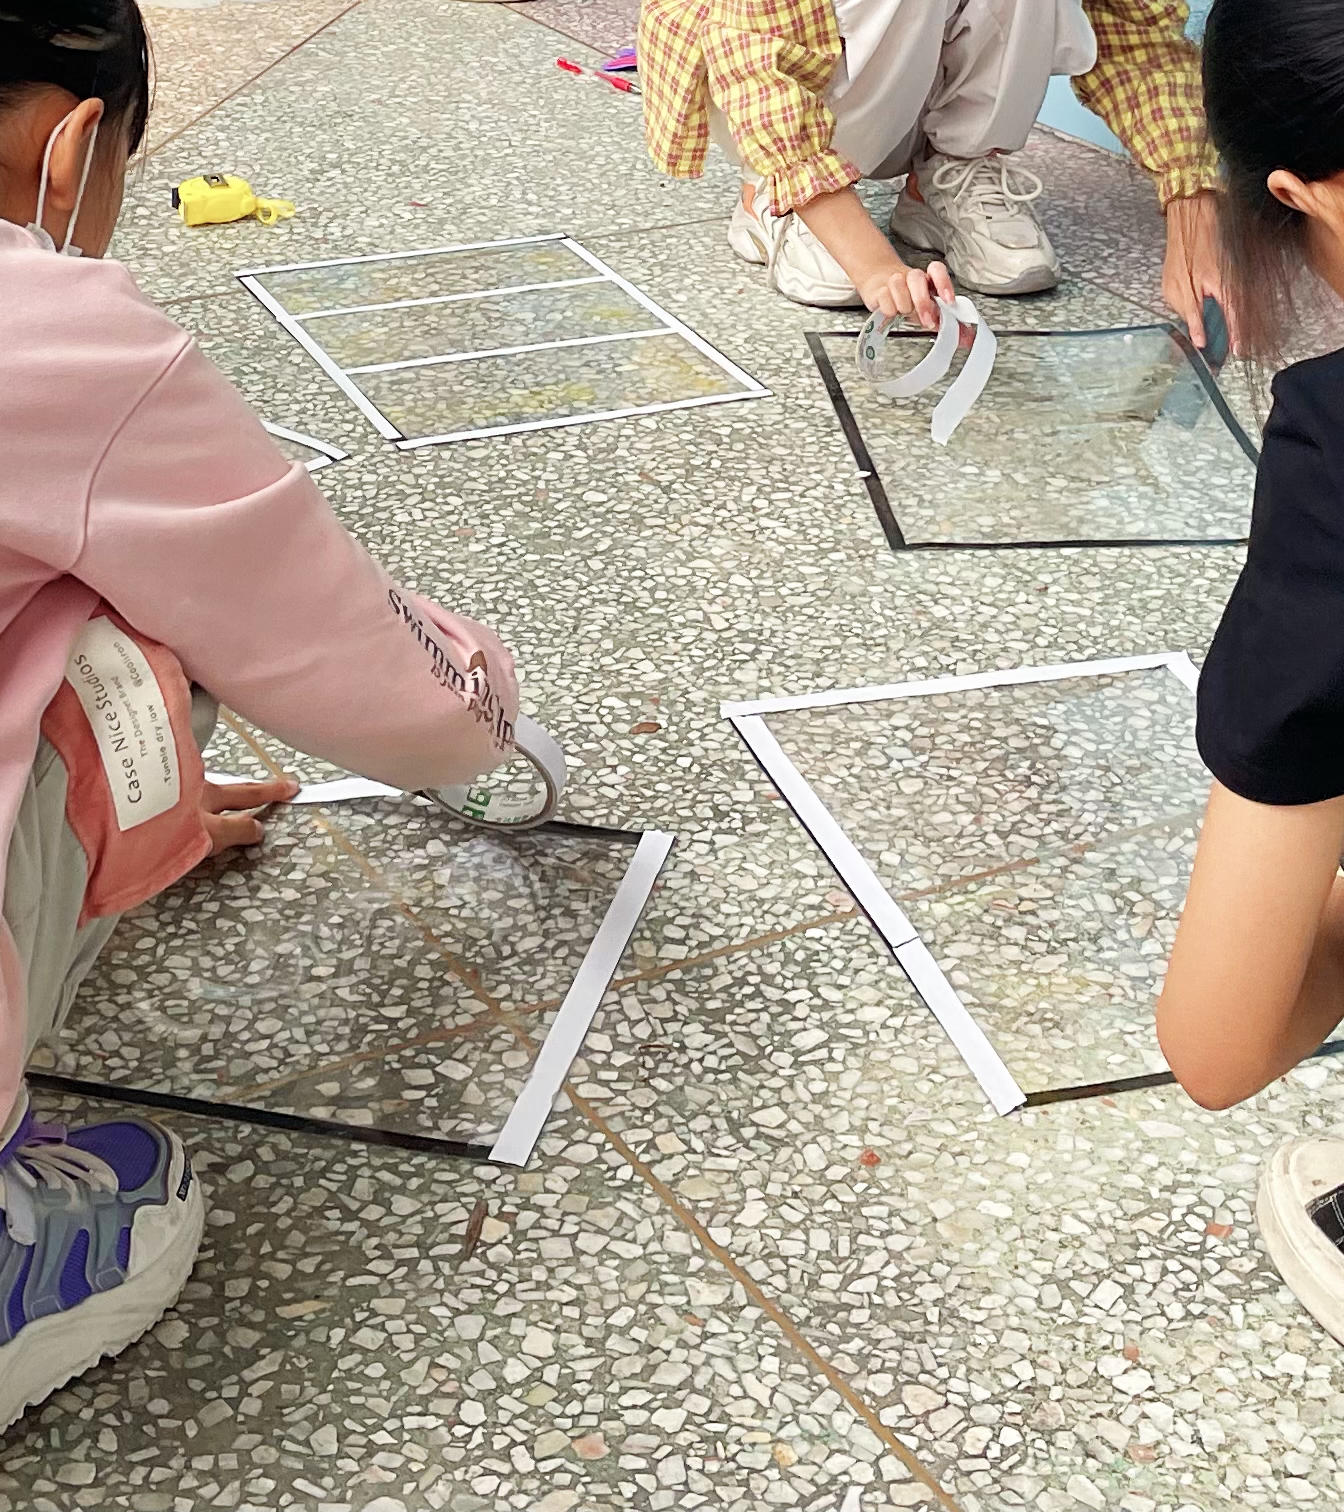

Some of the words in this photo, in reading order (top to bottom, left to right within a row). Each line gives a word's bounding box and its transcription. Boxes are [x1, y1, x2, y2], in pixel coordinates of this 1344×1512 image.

[74, 654, 113, 711] Studios
[105, 709, 129, 753] Nice
[146, 704, 158, 724] low
[154, 725, 165, 743] dry
[122, 758, 143, 804] Case
